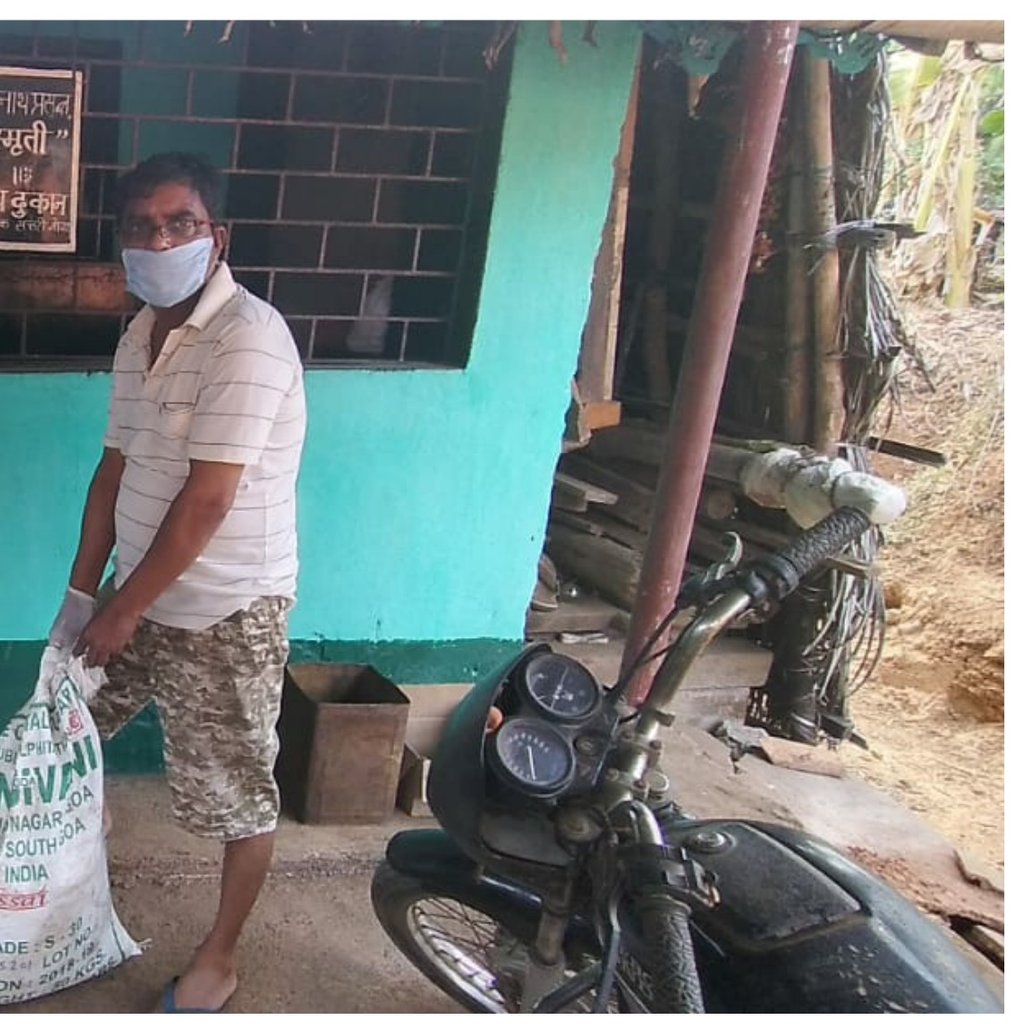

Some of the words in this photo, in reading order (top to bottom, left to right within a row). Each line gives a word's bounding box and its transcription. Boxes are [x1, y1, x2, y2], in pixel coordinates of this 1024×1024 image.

[11, 191, 69, 219] दुकान
[5, 838, 58, 858] SOUTH
[4, 864, 49, 884] INDIA
[42, 944, 70, 968] LOT
